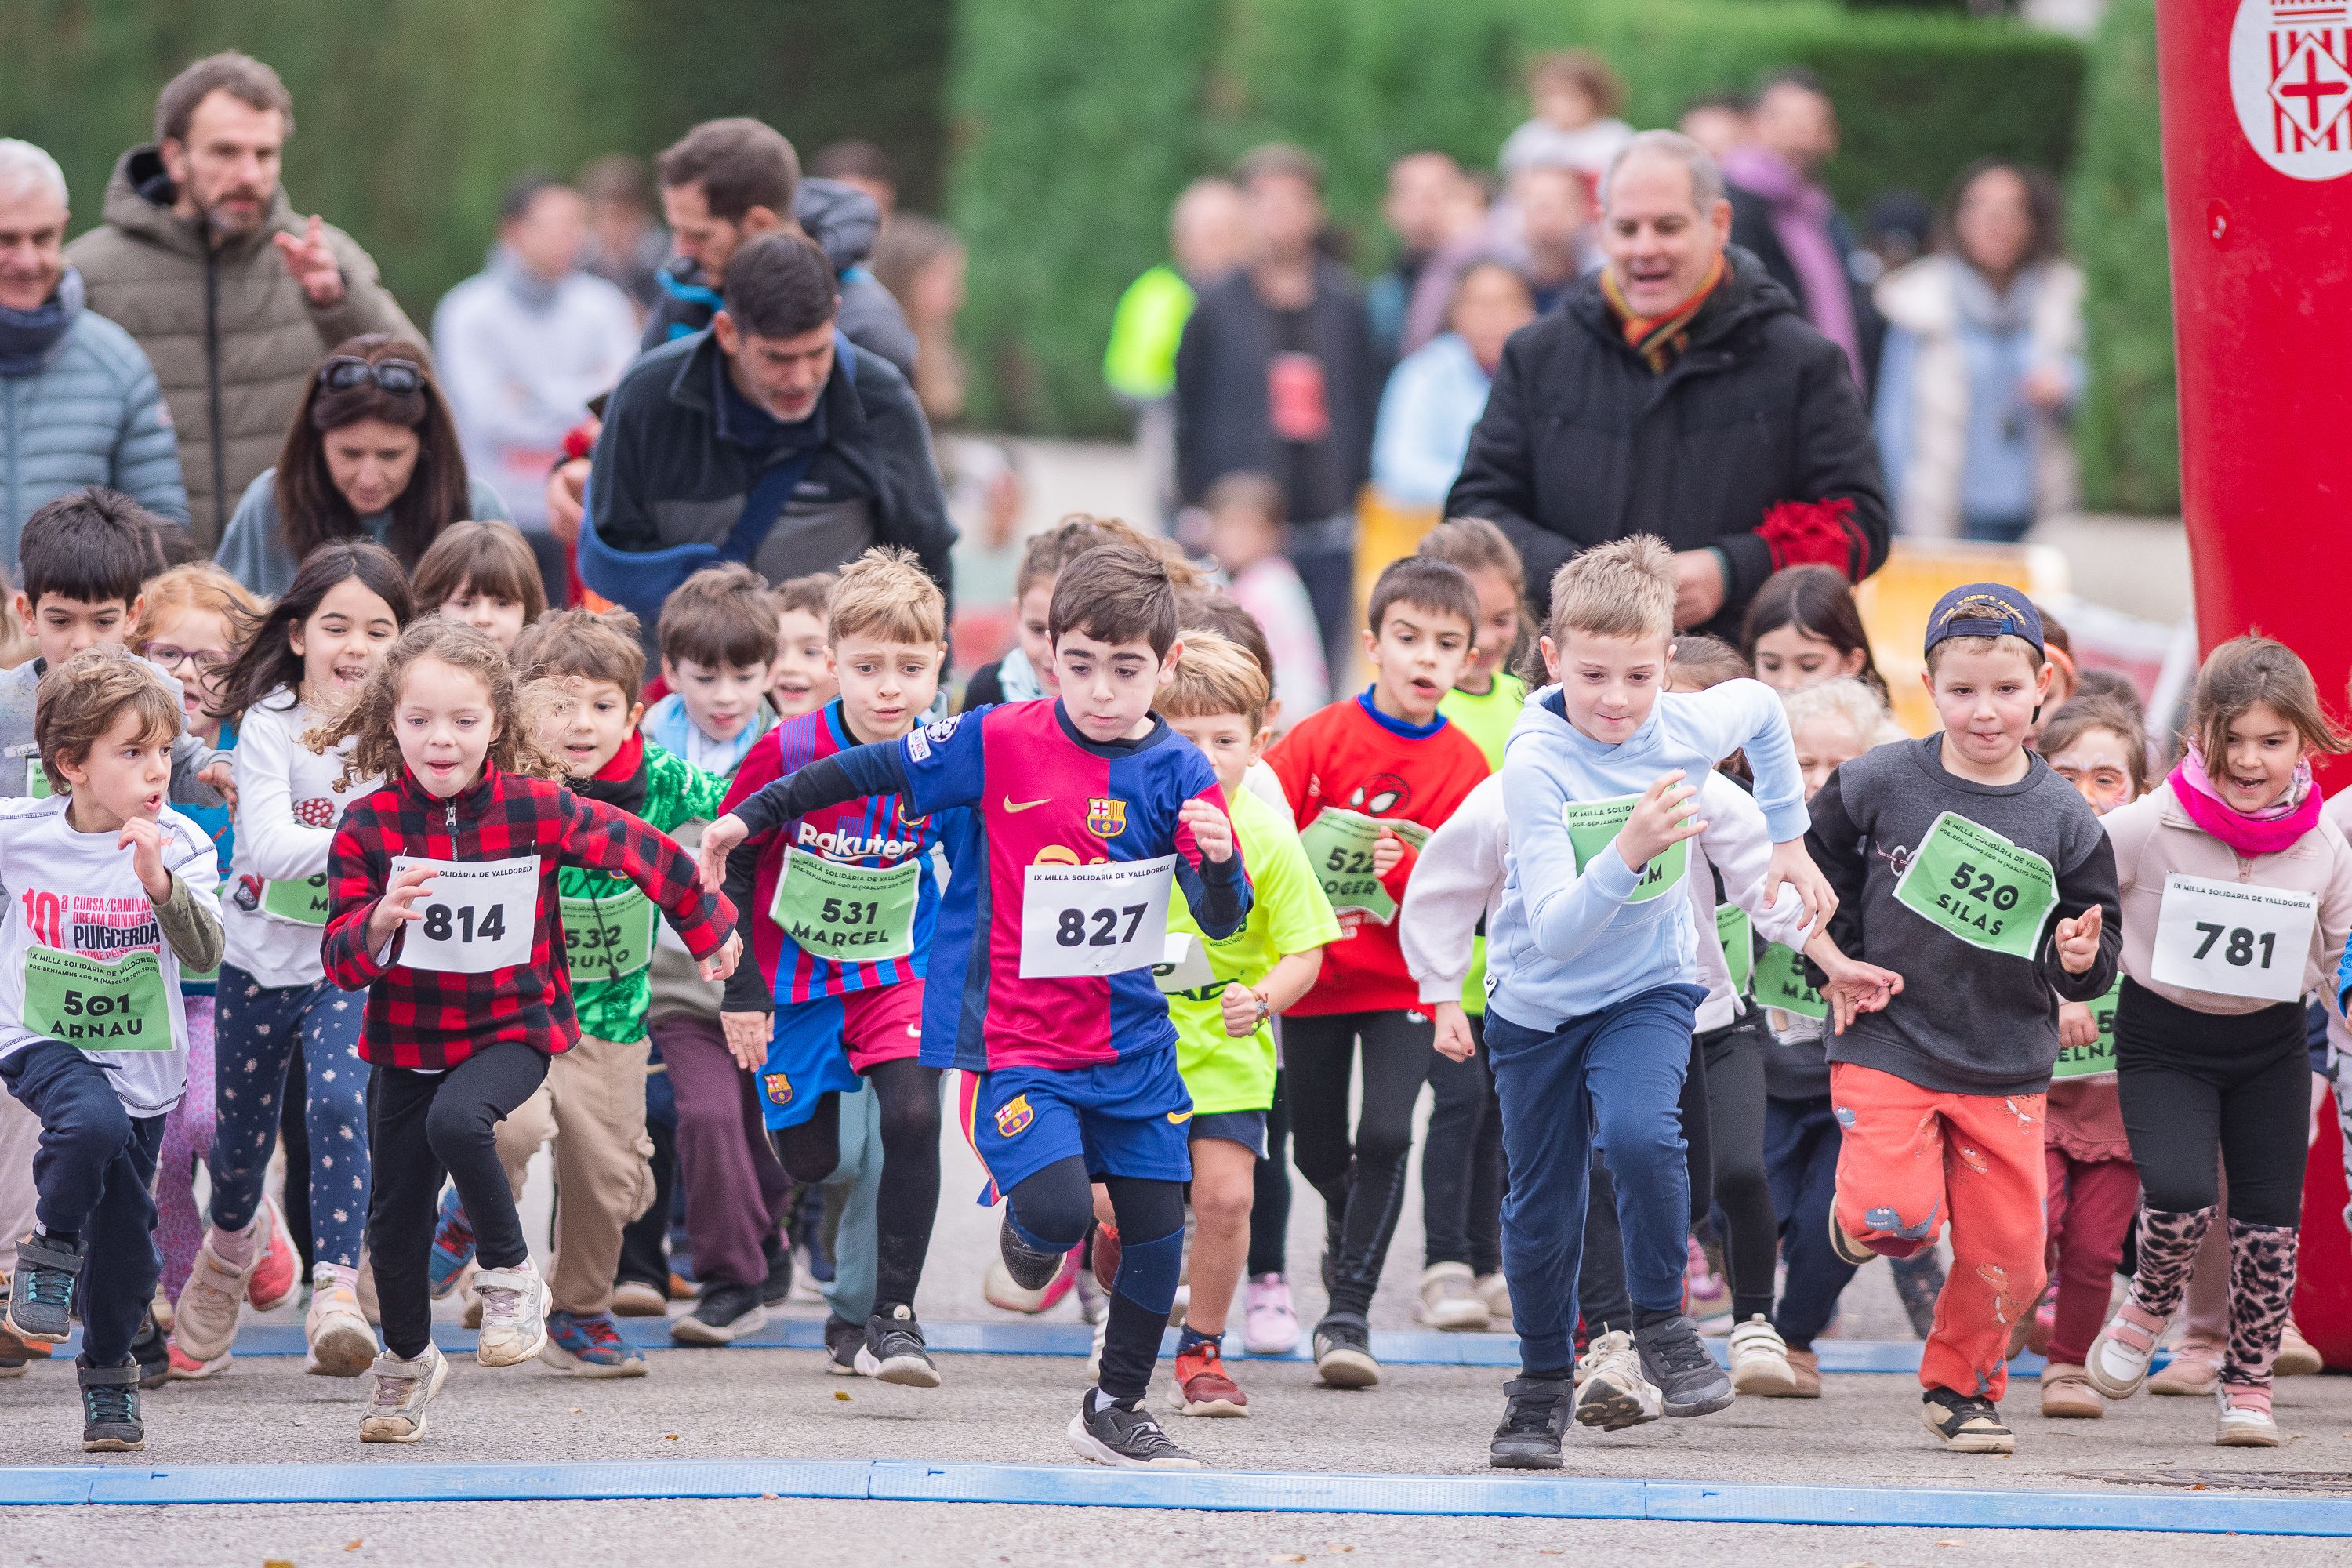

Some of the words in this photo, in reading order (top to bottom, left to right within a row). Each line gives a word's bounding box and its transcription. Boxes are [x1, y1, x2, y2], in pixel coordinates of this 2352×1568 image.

[797, 821, 919, 862] Rakuten
[1951, 822, 1973, 837] MILLA
[2013, 855, 2024, 864] DE
[439, 869, 477, 879] OLIDÀRIA
[492, 865, 533, 877] VALLDOREIX
[802, 859, 823, 873] MILLA
[824, 869, 864, 881] SOLIDÀRIA
[1072, 872, 1113, 881] SOLIDÀRIA
[1127, 864, 1170, 878] VALLDOREIX
[1324, 879, 1378, 895] OGER
[1949, 861, 2020, 911] 520
[2183, 884, 2206, 894] MILLA
[2209, 887, 2249, 901] SOLIDÀRIA
[2263, 896, 2310, 909] VALLDOREIX
[72, 911, 106, 925] DREAM
[107, 912, 151, 927] RUNNERS
[423, 902, 506, 943] 814
[820, 897, 879, 925] 531
[1936, 893, 2005, 936] SILAS
[73, 916, 161, 950] PUIGCERDÀ
[564, 924, 622, 949] 532
[790, 920, 890, 946] MARCEL
[1055, 902, 1149, 947] 827
[2192, 920, 2277, 969] 781
[39, 954, 62, 965] MILLA
[64, 960, 104, 975] SOLIDÀRIA
[119, 956, 158, 975] VALLDOREIX
[100, 976, 129, 985] (NASCUTS
[63, 989, 130, 1017] 501
[49, 1018, 143, 1039] ARNAU
